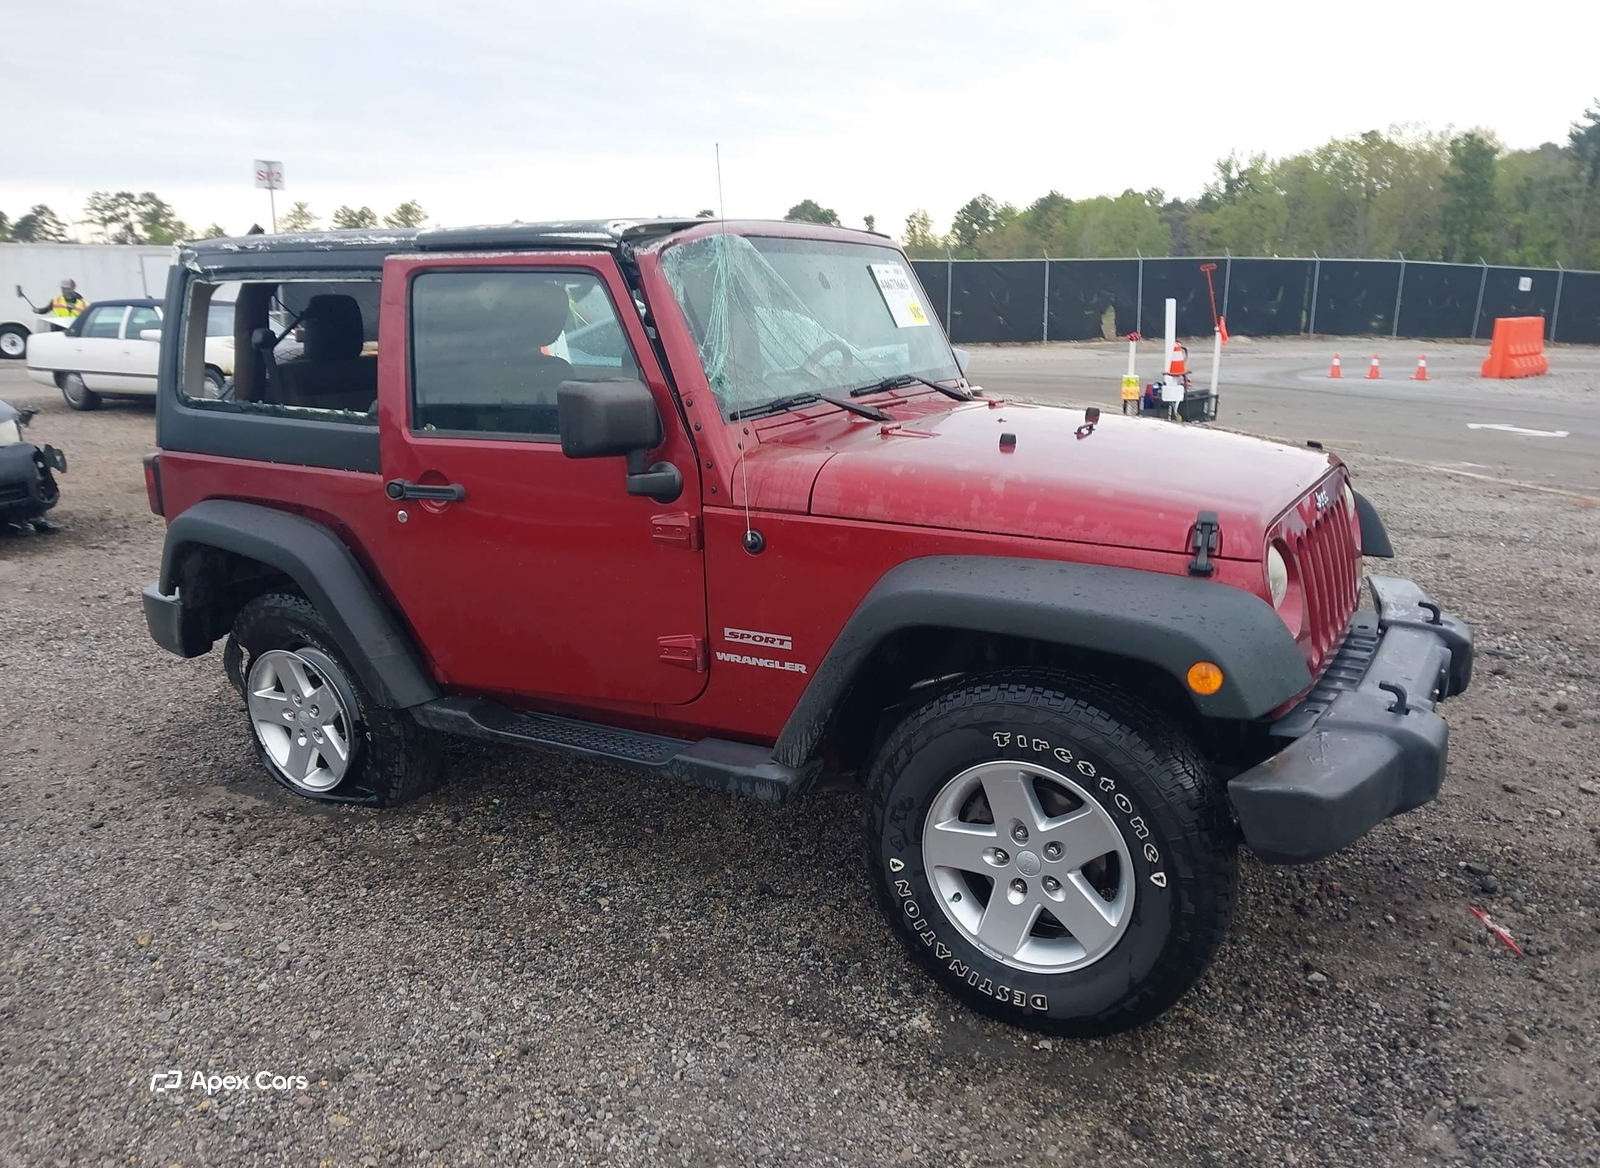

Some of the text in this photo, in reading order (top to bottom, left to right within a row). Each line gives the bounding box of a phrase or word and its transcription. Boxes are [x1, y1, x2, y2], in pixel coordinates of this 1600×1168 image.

[715, 651, 807, 674] WRANGLER
[726, 630, 790, 647] SPORT
[993, 732, 1159, 863] Firestone
[894, 879, 1049, 1011] DESTINATION
